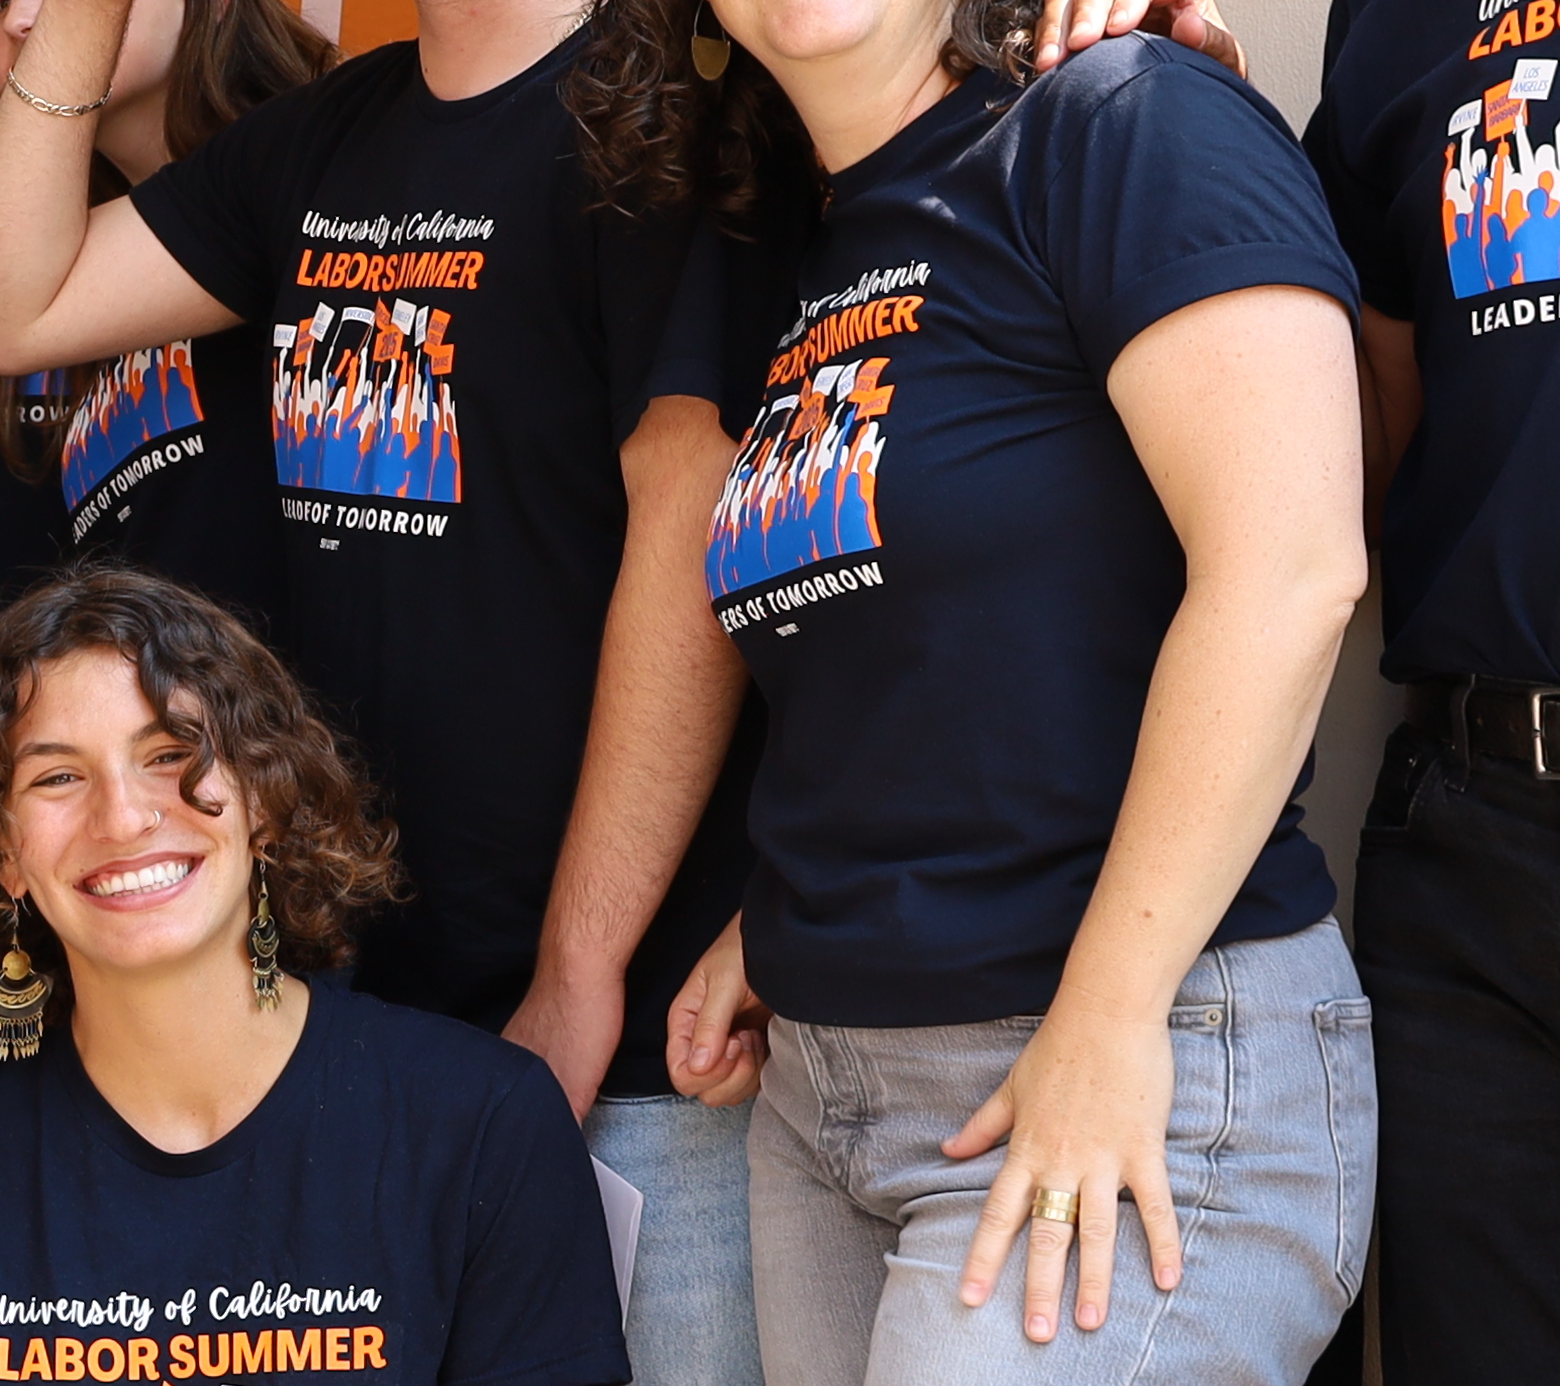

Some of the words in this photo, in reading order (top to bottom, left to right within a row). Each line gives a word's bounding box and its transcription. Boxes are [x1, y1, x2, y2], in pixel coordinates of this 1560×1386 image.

[1512, 79, 1549, 93] ANGELES
[1523, 66, 1540, 80] LOS
[406, 209, 495, 243] California
[296, 249, 381, 292] LABOR
[72, 500, 101, 545] ADERS
[97, 486, 112, 510] OF
[109, 434, 205, 498] TOMORROW
[746, 597, 768, 622] OF
[766, 562, 884, 614] TOMORROW
[164, 1288, 197, 1326] of
[208, 1280, 382, 1319] California
[168, 1326, 388, 1378] SUMMER
